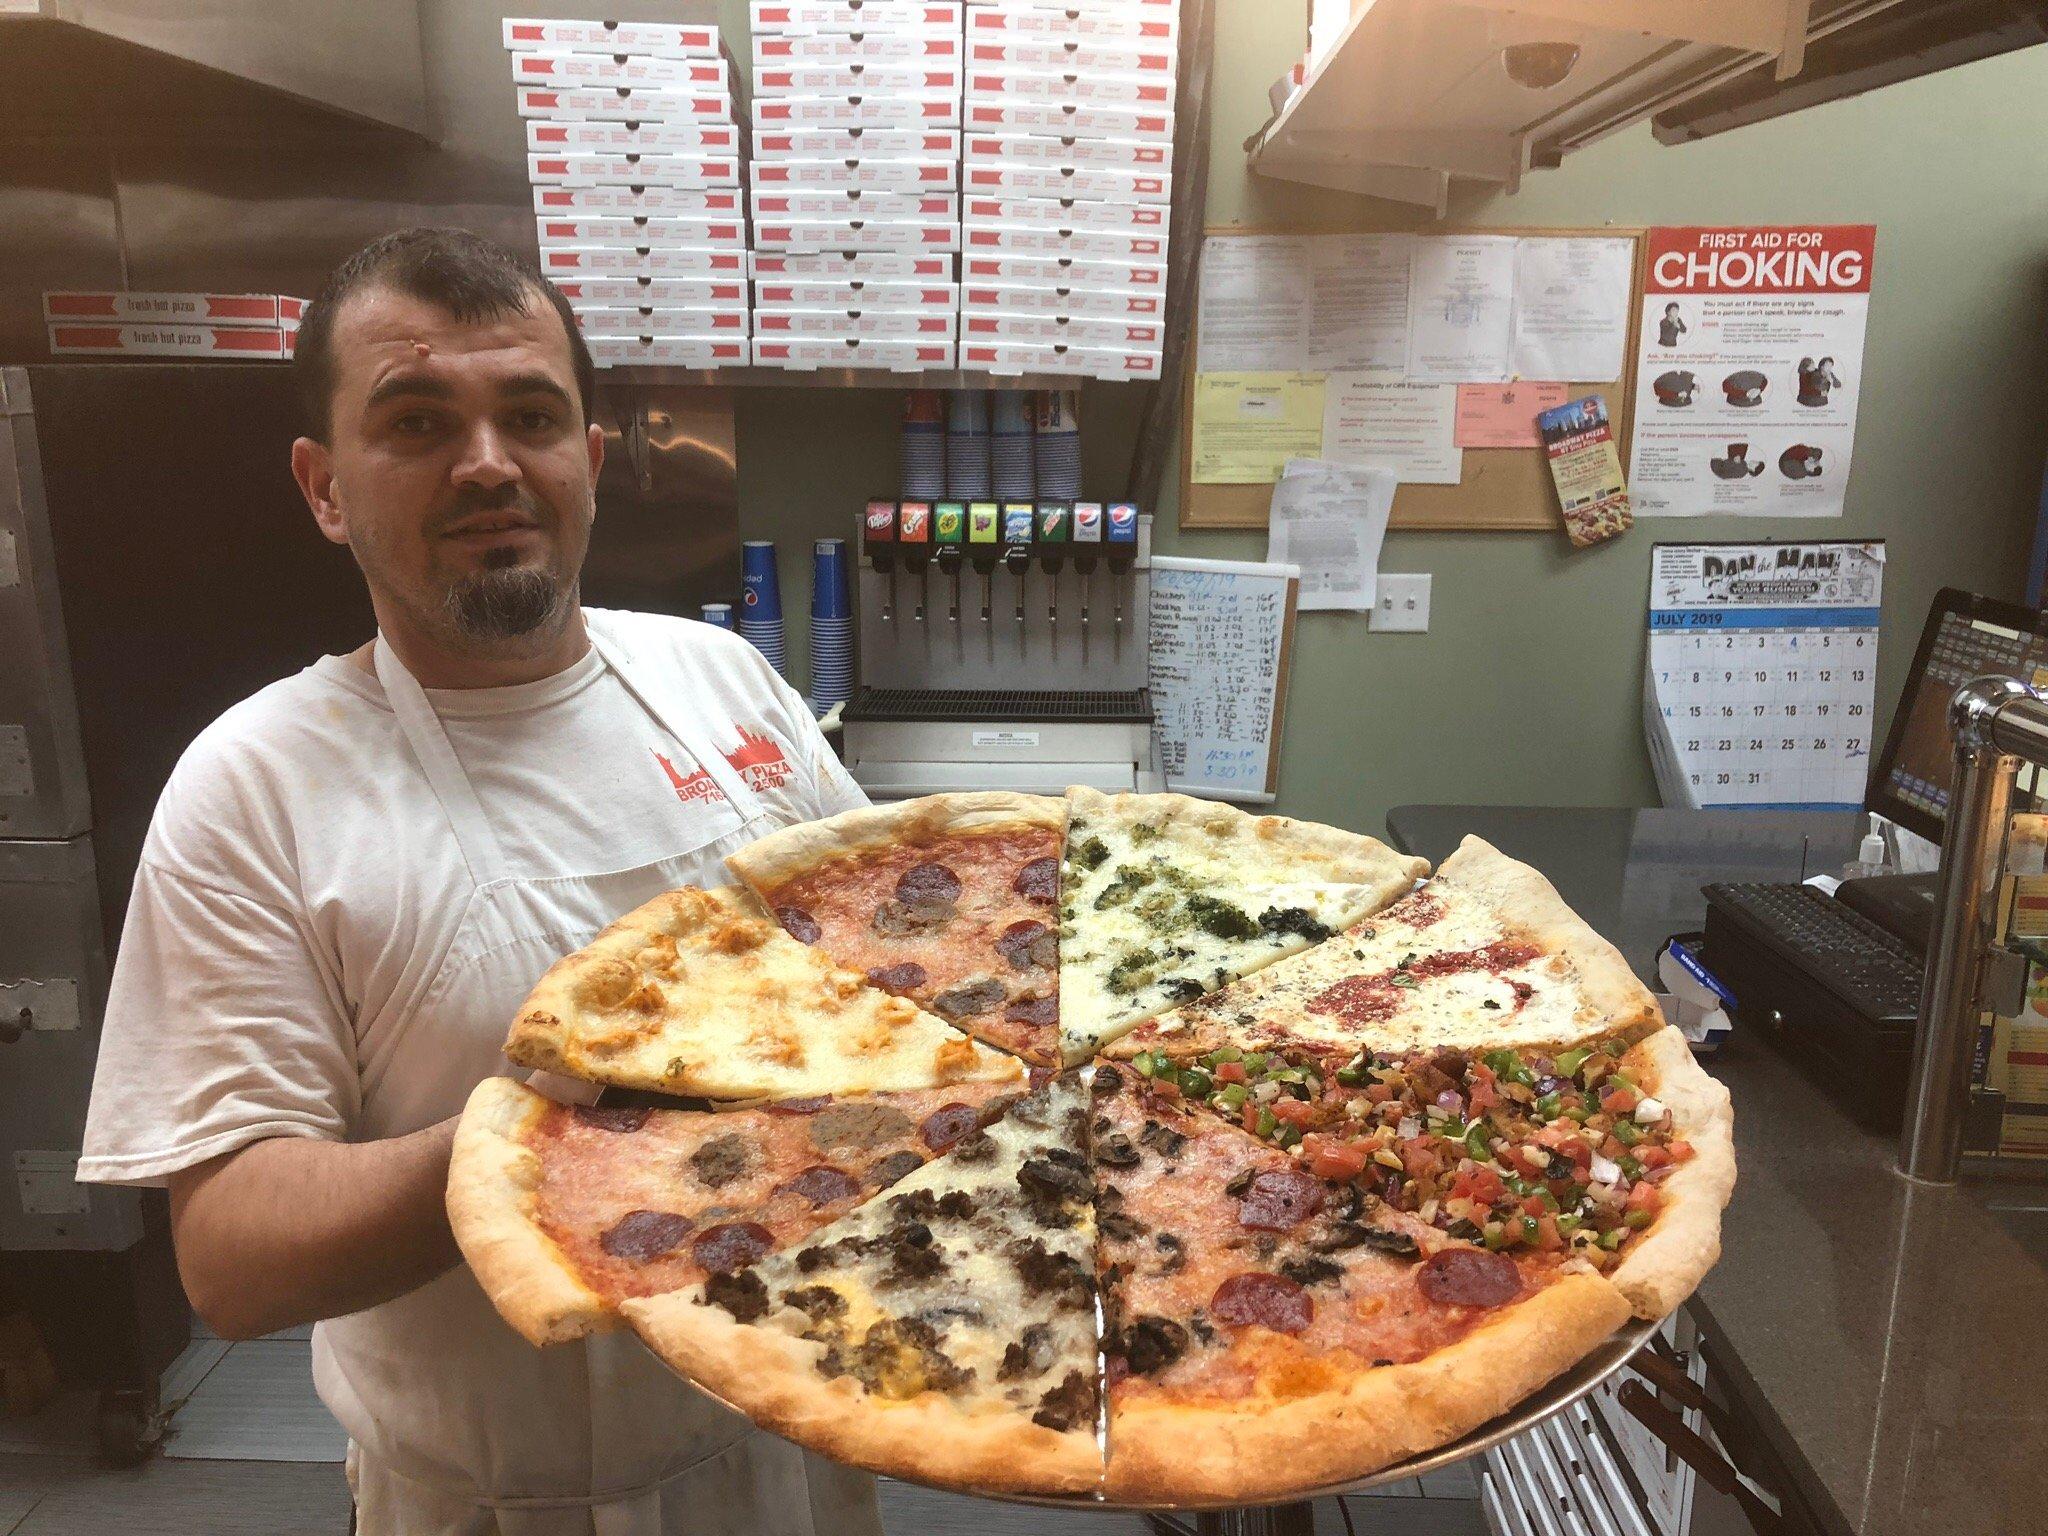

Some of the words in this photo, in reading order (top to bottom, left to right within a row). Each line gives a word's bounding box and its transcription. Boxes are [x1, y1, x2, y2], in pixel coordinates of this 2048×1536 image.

[1700, 233, 1747, 248] FIRST
[1751, 233, 1782, 247] AID
[1787, 233, 1822, 247] FOR
[1653, 250, 1863, 287] CHOKING
[172, 302, 195, 314] pizza
[160, 332, 175, 343] hot
[178, 334, 202, 346] pizza
[1654, 614, 1686, 625] JULY
[1691, 613, 1723, 625] 2019
[1695, 638, 1701, 649] 1
[1727, 637, 1733, 648] 2
[1758, 637, 1765, 648] 3
[1790, 636, 1797, 647] 4
[1823, 636, 1830, 647] 5
[1856, 636, 1864, 647] 6
[1662, 672, 1669, 683] 7
[1693, 672, 1700, 683] 8
[1725, 671, 1732, 682] 9
[1755, 671, 1767, 682] 10
[1787, 671, 1798, 682] 11
[1819, 670, 1831, 682] 12
[1852, 670, 1864, 682] 13
[1690, 706, 1701, 717] 15
[1722, 706, 1733, 717] 16
[1753, 705, 1765, 716] 17
[1785, 705, 1797, 716] 18
[1817, 705, 1829, 716] 19
[1848, 704, 1863, 716] 20
[1688, 740, 1700, 751] 22
[1719, 740, 1731, 751] 23
[1750, 740, 1763, 750] 24
[1781, 739, 1794, 750] 25
[1813, 739, 1826, 750] 26
[1846, 739, 1860, 750] 27
[752, 762, 793, 779] PIZZA
[1717, 773, 1730, 784] 30
[1748, 773, 1760, 784] 31
